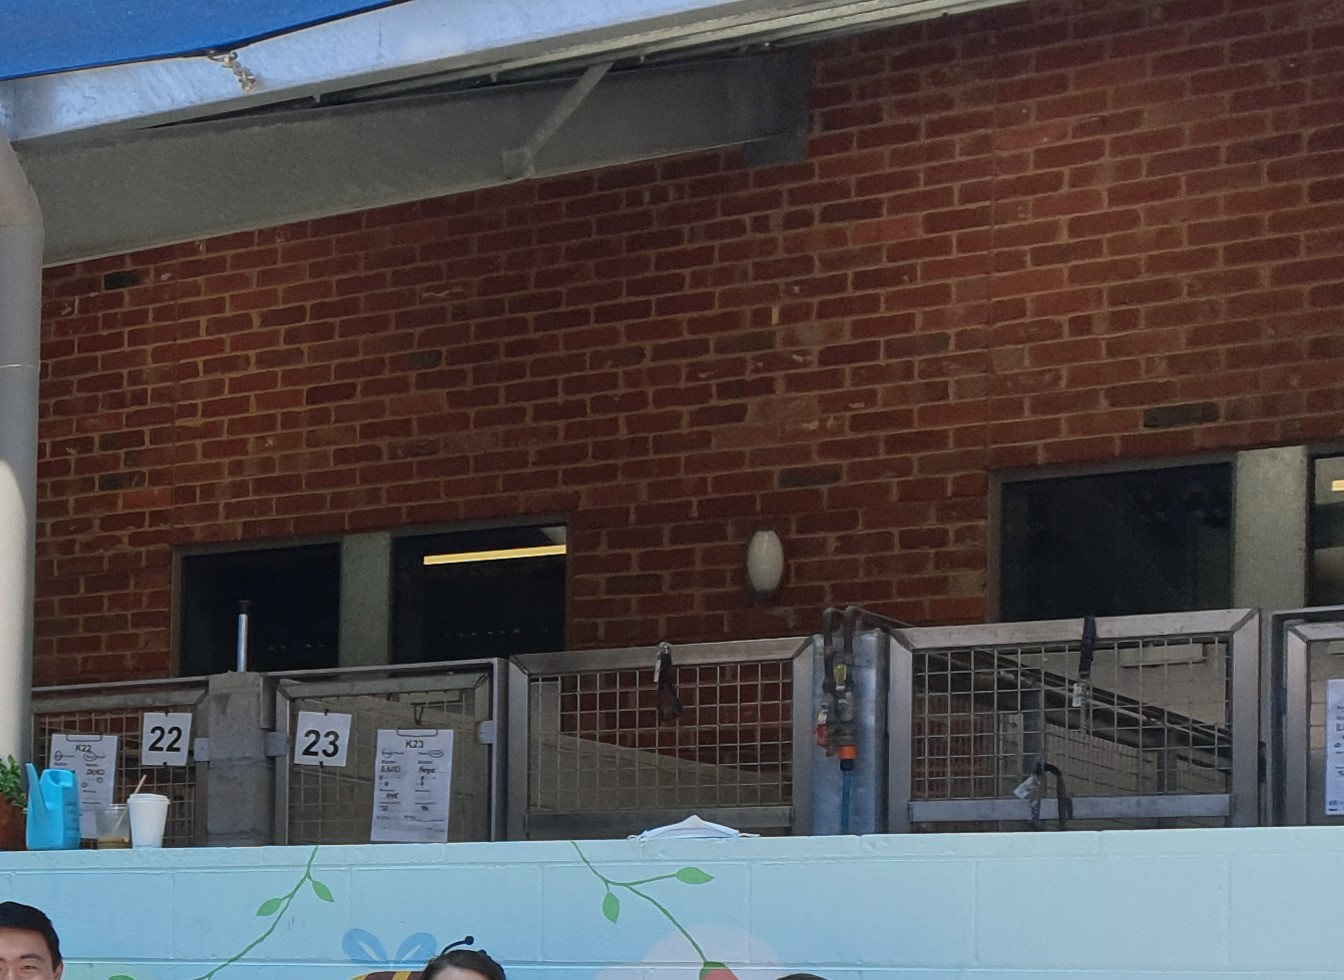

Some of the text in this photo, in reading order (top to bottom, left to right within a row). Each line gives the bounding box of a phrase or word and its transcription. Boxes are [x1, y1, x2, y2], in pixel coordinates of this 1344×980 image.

[75, 744, 92, 752] K22
[148, 726, 182, 752] 22
[302, 729, 340, 757] 23
[405, 739, 424, 749] K23
